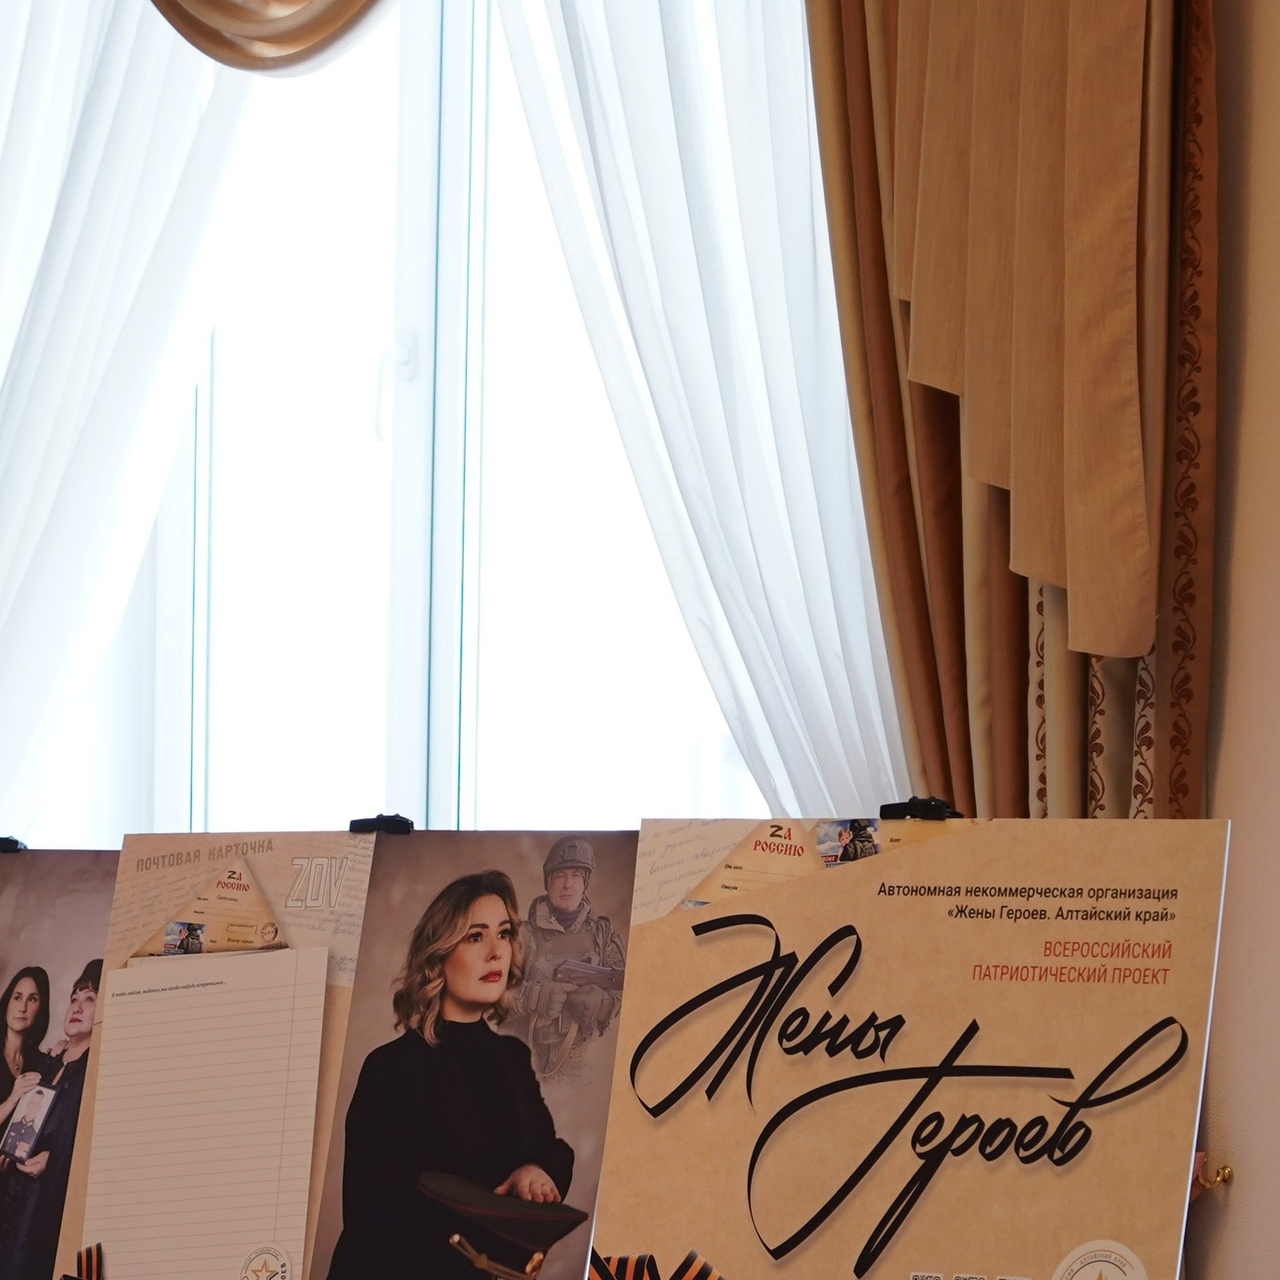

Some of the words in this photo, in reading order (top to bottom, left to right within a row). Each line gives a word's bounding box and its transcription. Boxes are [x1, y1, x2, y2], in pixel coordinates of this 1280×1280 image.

[136, 852, 202, 873] ПОЧТОВАЯ
[208, 838, 275, 860] КАРТОЧКА
[753, 839, 805, 857] РОССИЮ
[284, 856, 350, 909] ZOV
[877, 882, 961, 897] Автономная
[965, 884, 1083, 901] некоммерческая
[1087, 887, 1178, 902] организация
[947, 905, 996, 920] «Жены
[999, 905, 1051, 923] Героев.
[1055, 906, 1131, 922] Алтайский
[1135, 907, 1176, 925] край»
[1043, 939, 1173, 960] ВСЕРОССИЙСКИЙ
[972, 963, 1108, 984] ПАТРИОТИЧЕСКИЙ
[1111, 967, 1171, 986] ПРОЕКТ
[629, 913, 905, 1118] Жены
[747, 1016, 1189, 1280] Героев
[1079, 1252, 1112, 1266] АЛТАЙСКИЙ
